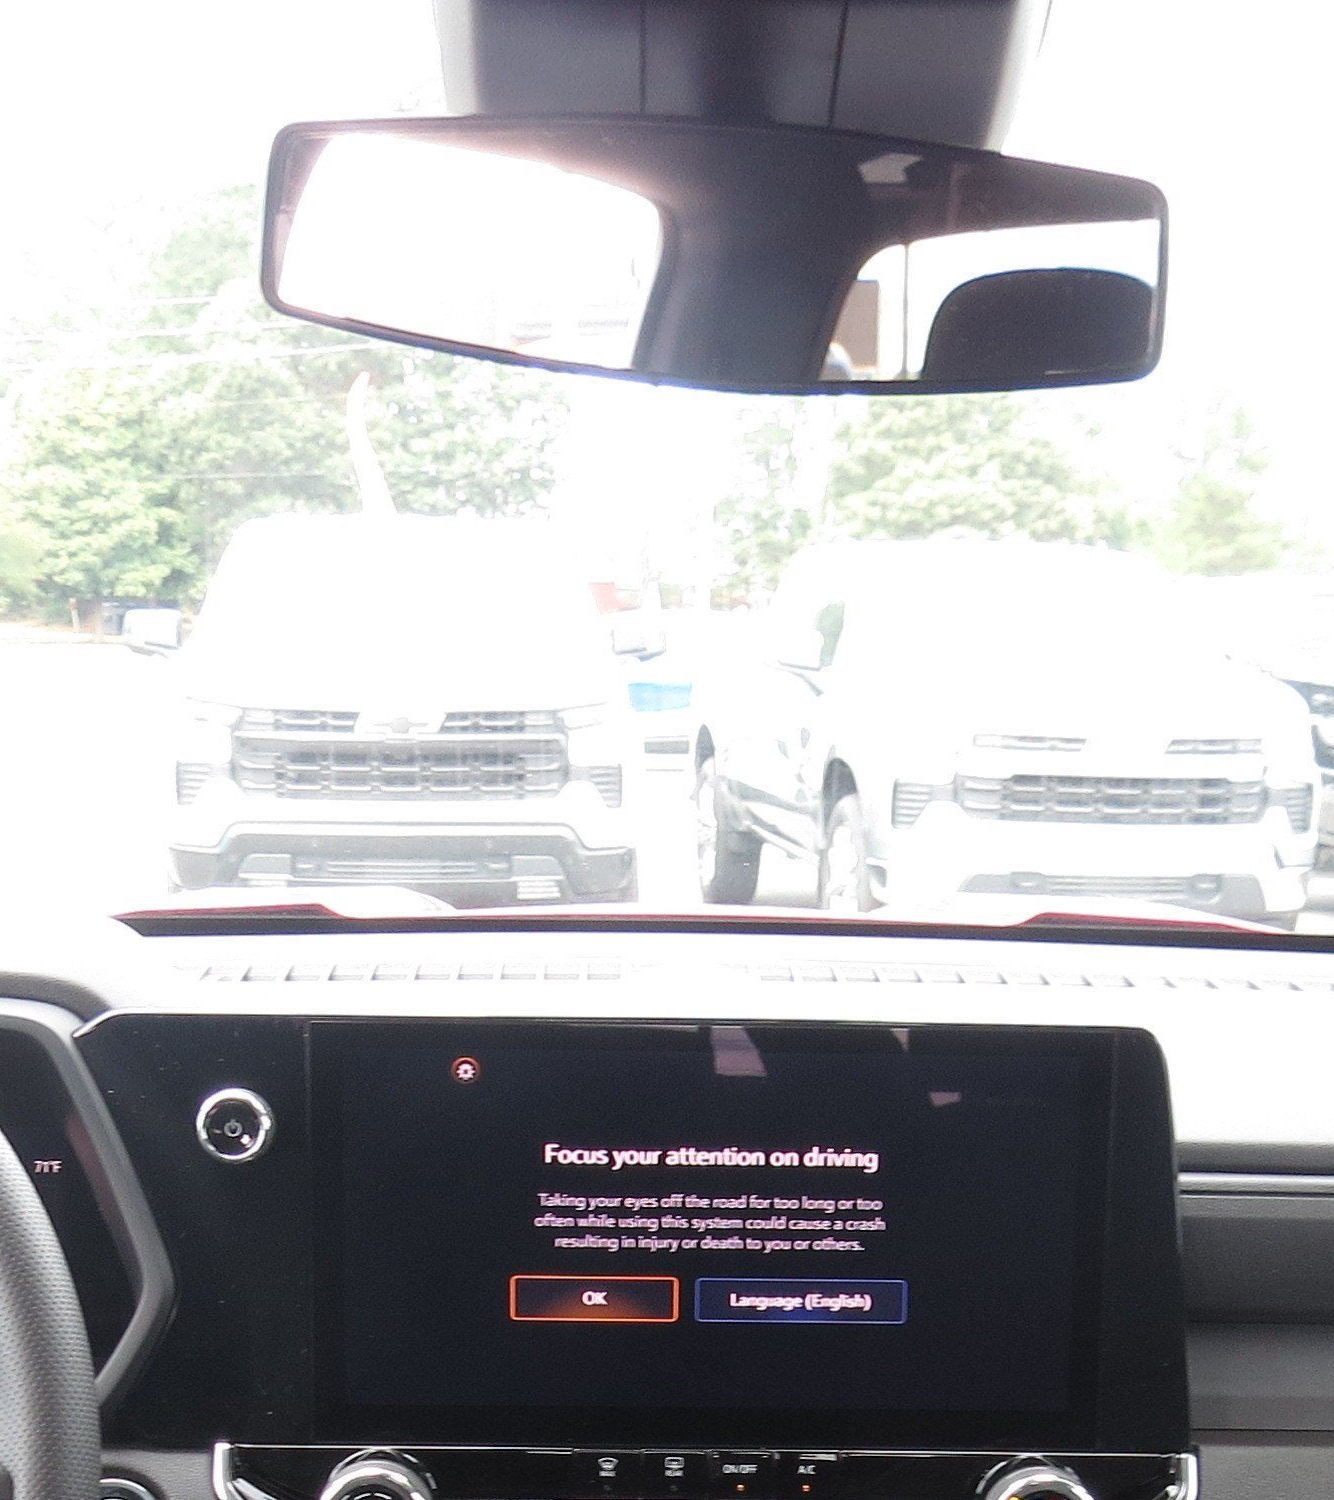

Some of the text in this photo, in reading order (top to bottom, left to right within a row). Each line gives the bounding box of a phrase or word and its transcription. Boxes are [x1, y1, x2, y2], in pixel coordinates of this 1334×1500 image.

[543, 1143, 880, 1173] Focus your attention on driving
[537, 1193, 883, 1213] Taking your eyes off the road for too long or too
[534, 1214, 887, 1232] often while using this system could cause a crash
[554, 1234, 865, 1253] resulting in injury or death to you or others.
[582, 1291, 607, 1305] OK
[729, 1293, 872, 1311] Language (English)
